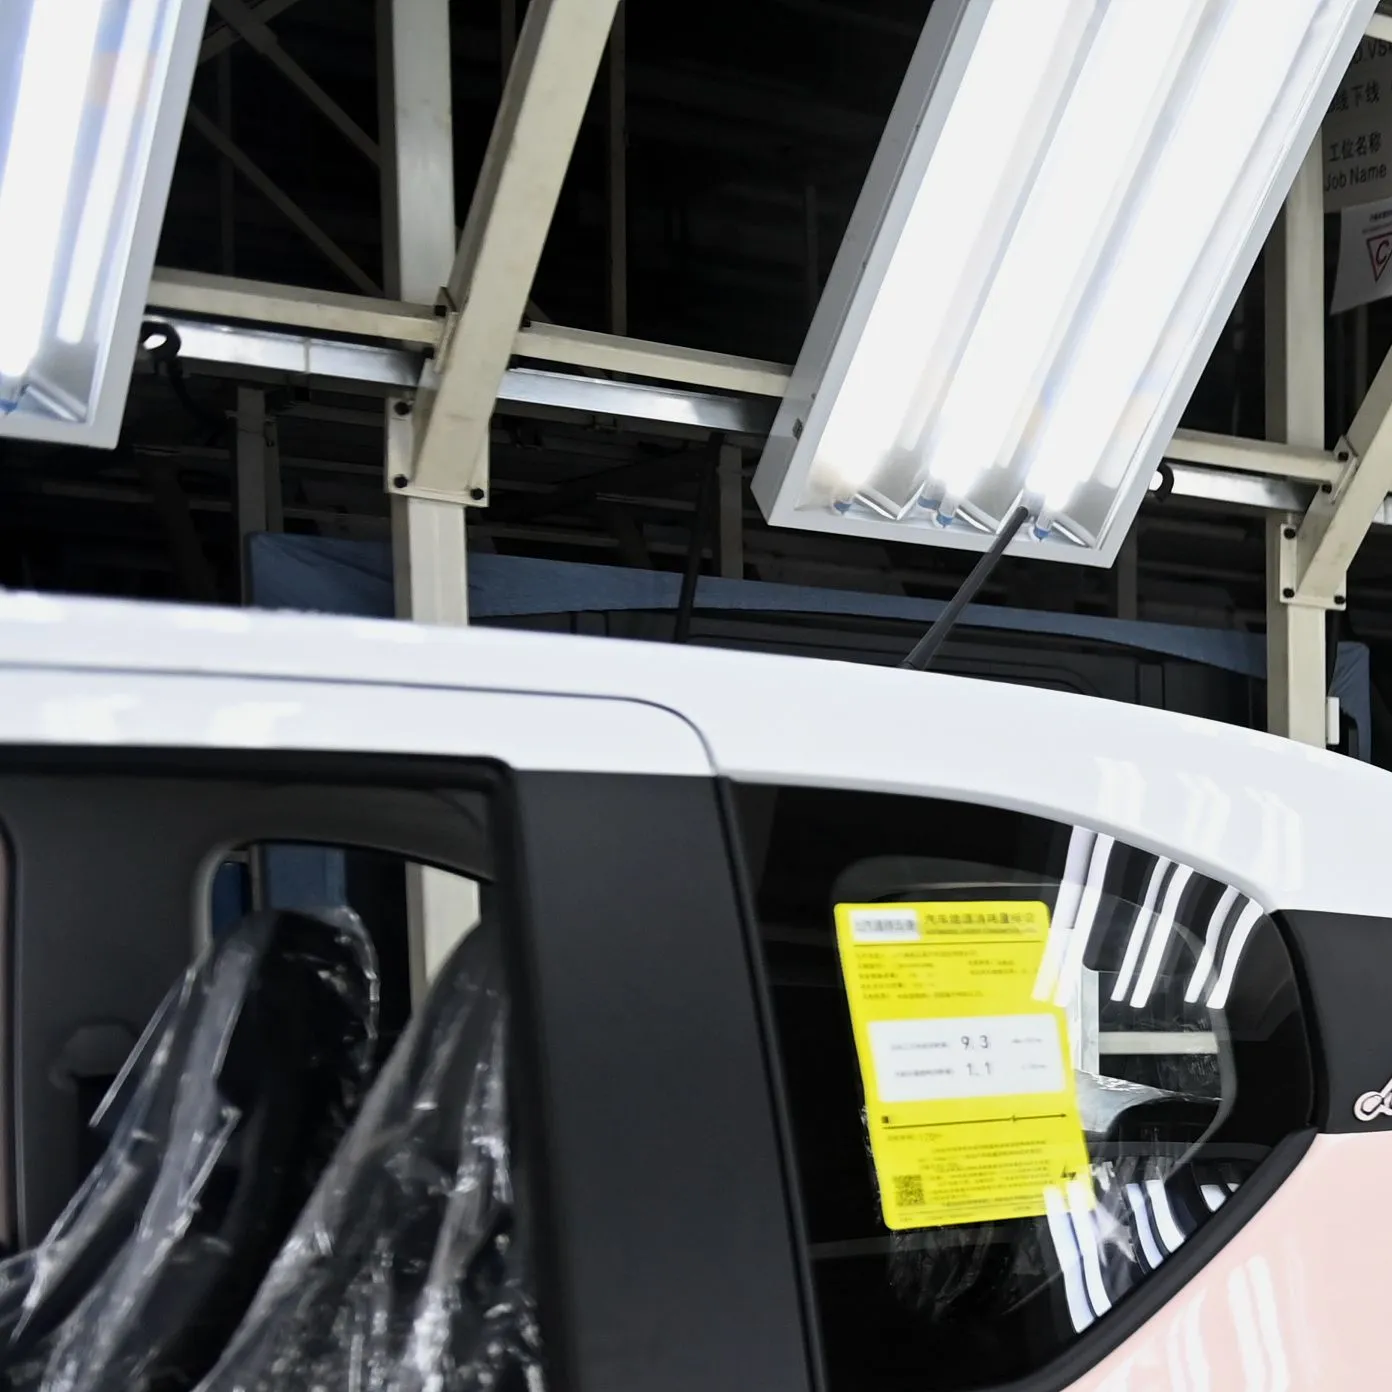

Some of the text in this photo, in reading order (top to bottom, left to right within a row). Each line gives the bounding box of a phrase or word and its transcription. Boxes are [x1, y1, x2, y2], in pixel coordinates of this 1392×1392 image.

[1328, 131, 1382, 162] 工位名称
[1325, 163, 1387, 191] Job Name
[1375, 239, 1390, 265] C
